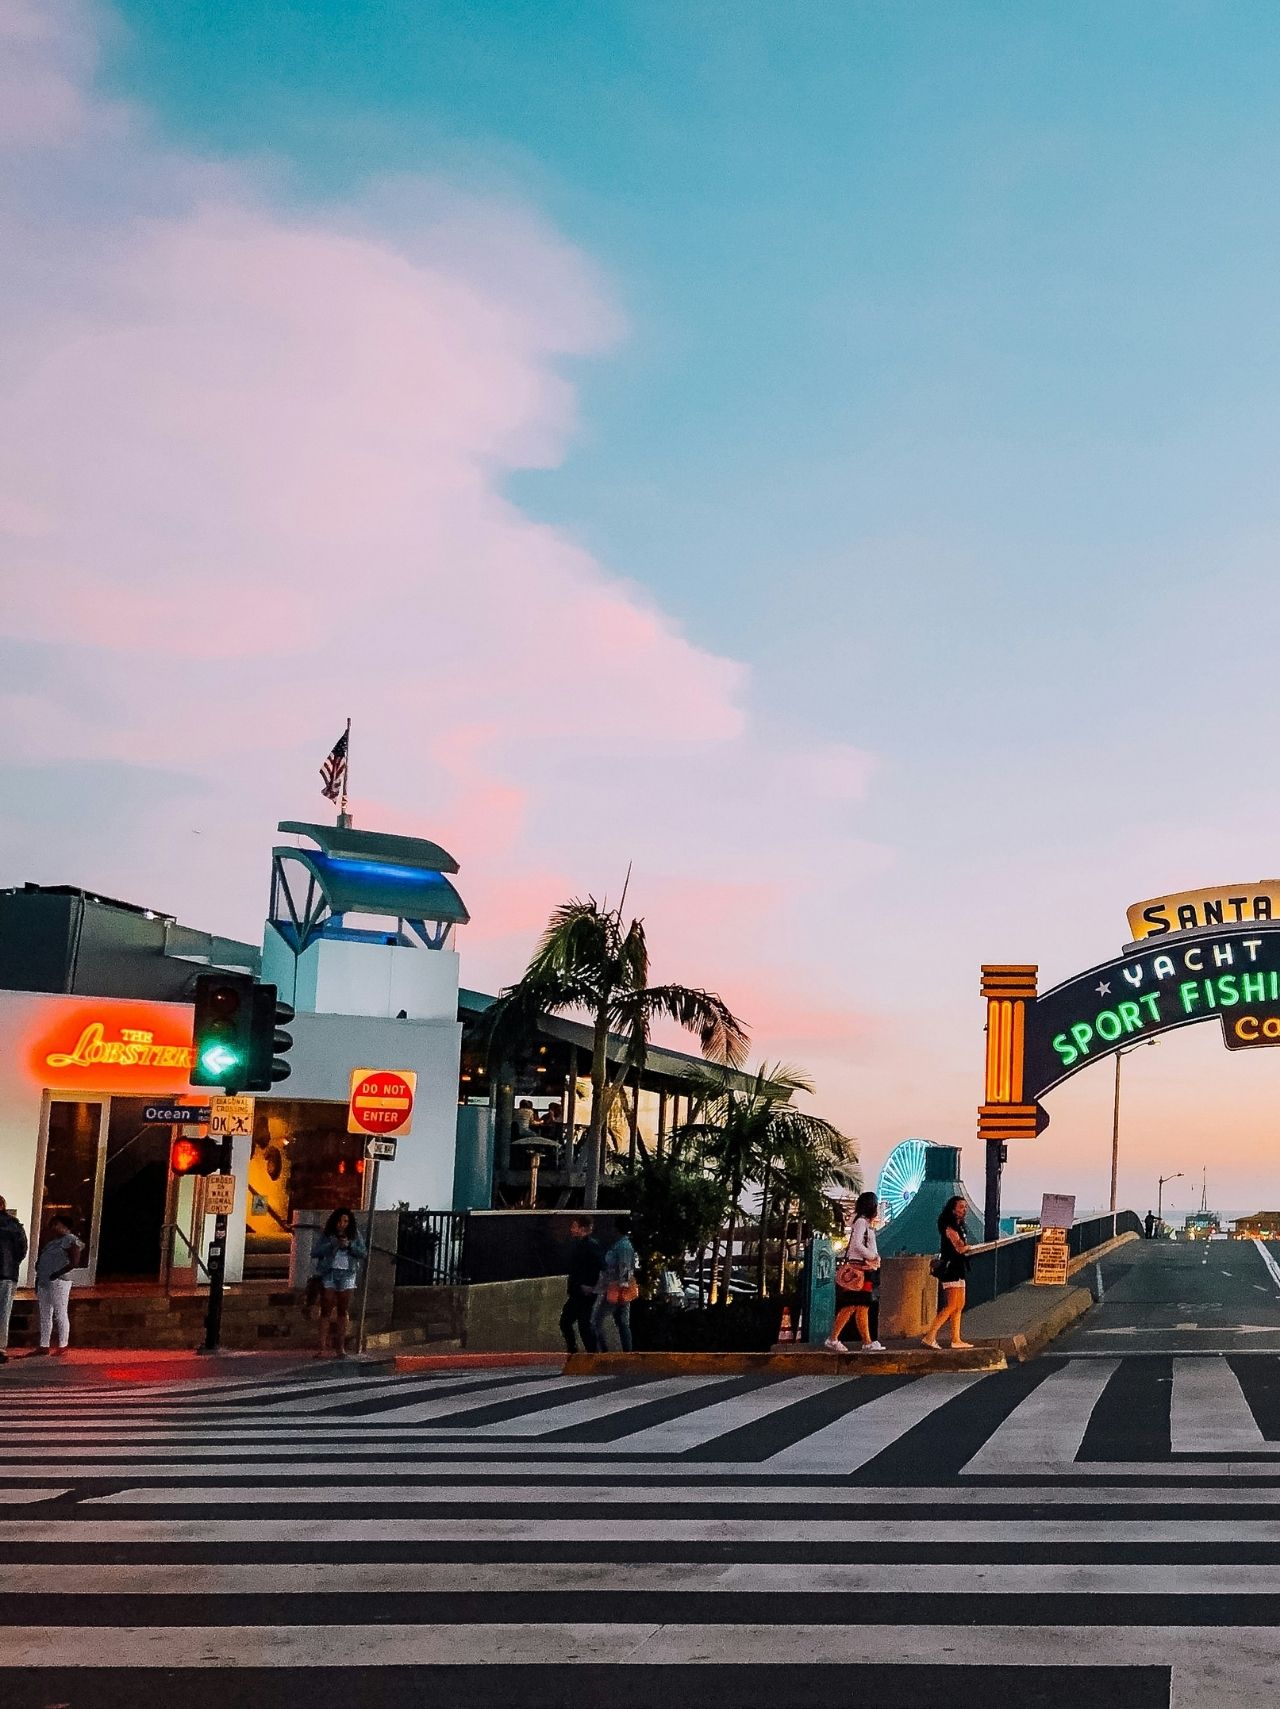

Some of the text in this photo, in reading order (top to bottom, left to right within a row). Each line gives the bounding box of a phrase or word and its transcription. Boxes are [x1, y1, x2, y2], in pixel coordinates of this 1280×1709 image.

[1143, 895, 1273, 938] SANTA
[1122, 939, 1262, 988] YACHT
[120, 1028, 154, 1044] THE
[1052, 991, 1161, 1066] SPORT
[362, 1083, 406, 1095] DO NOT
[216, 1097, 248, 1106] DIAGONAL
[146, 1108, 190, 1119] Ocean
[363, 1110, 398, 1122] ENTER
[212, 1116, 227, 1131] OK
